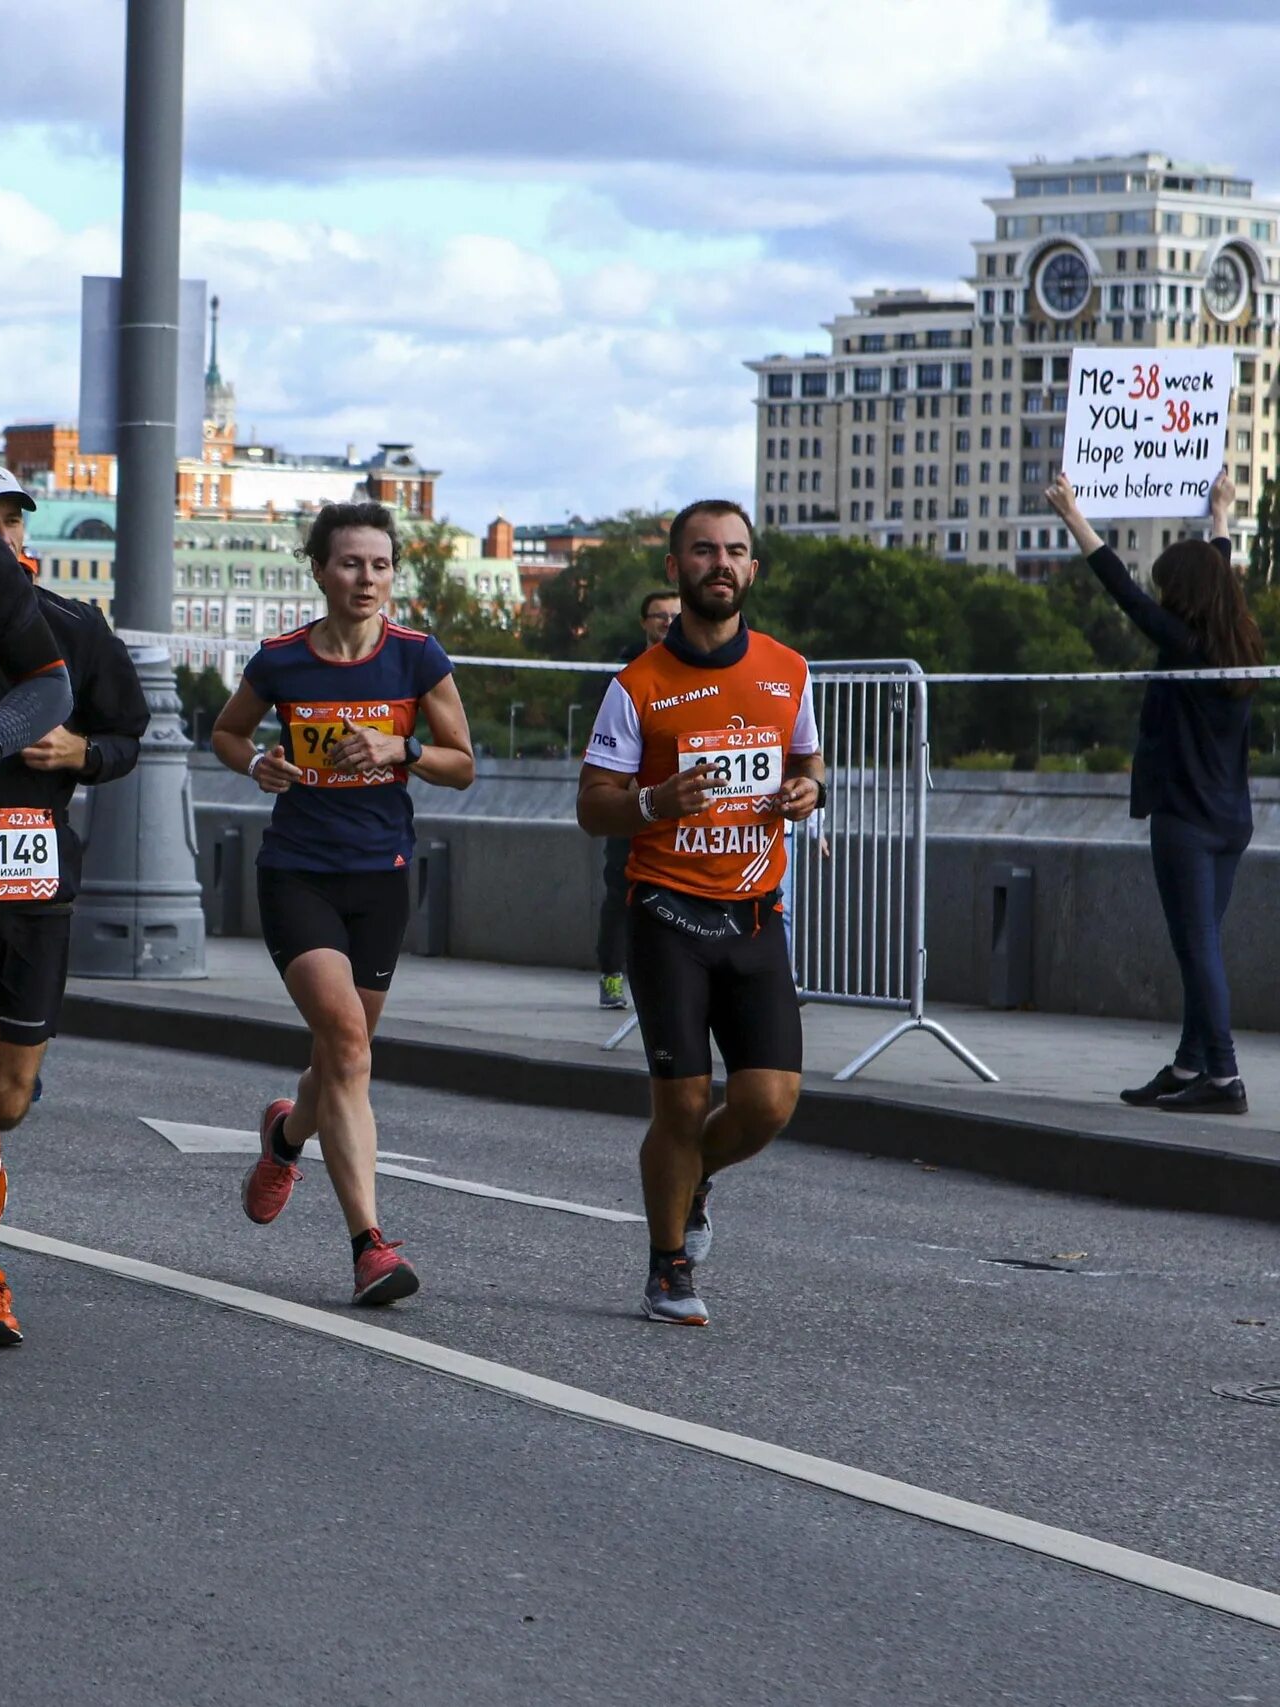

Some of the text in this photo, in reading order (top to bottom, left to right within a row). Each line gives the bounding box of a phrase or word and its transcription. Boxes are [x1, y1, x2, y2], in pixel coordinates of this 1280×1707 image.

[1128, 364, 1160, 400] 38
[1165, 371, 1214, 392] week
[1162, 400, 1191, 433] 38
[1077, 437, 1124, 474] Hope
[1125, 473, 1173, 498] before
[1180, 479, 1210, 497] me
[336, 707, 364, 719] 42,2
[593, 733, 617, 748] ПСБ
[727, 733, 754, 746] 42,2
[307, 768, 318, 785] D
[711, 785, 753, 796] МИХАИЛ
[727, 801, 749, 811] asics
[8, 813, 34, 826] 42,2
[674, 826, 770, 854] КАЗАНЬ
[7, 885, 28, 894] asics
[676, 916, 726, 937] Kalenji
